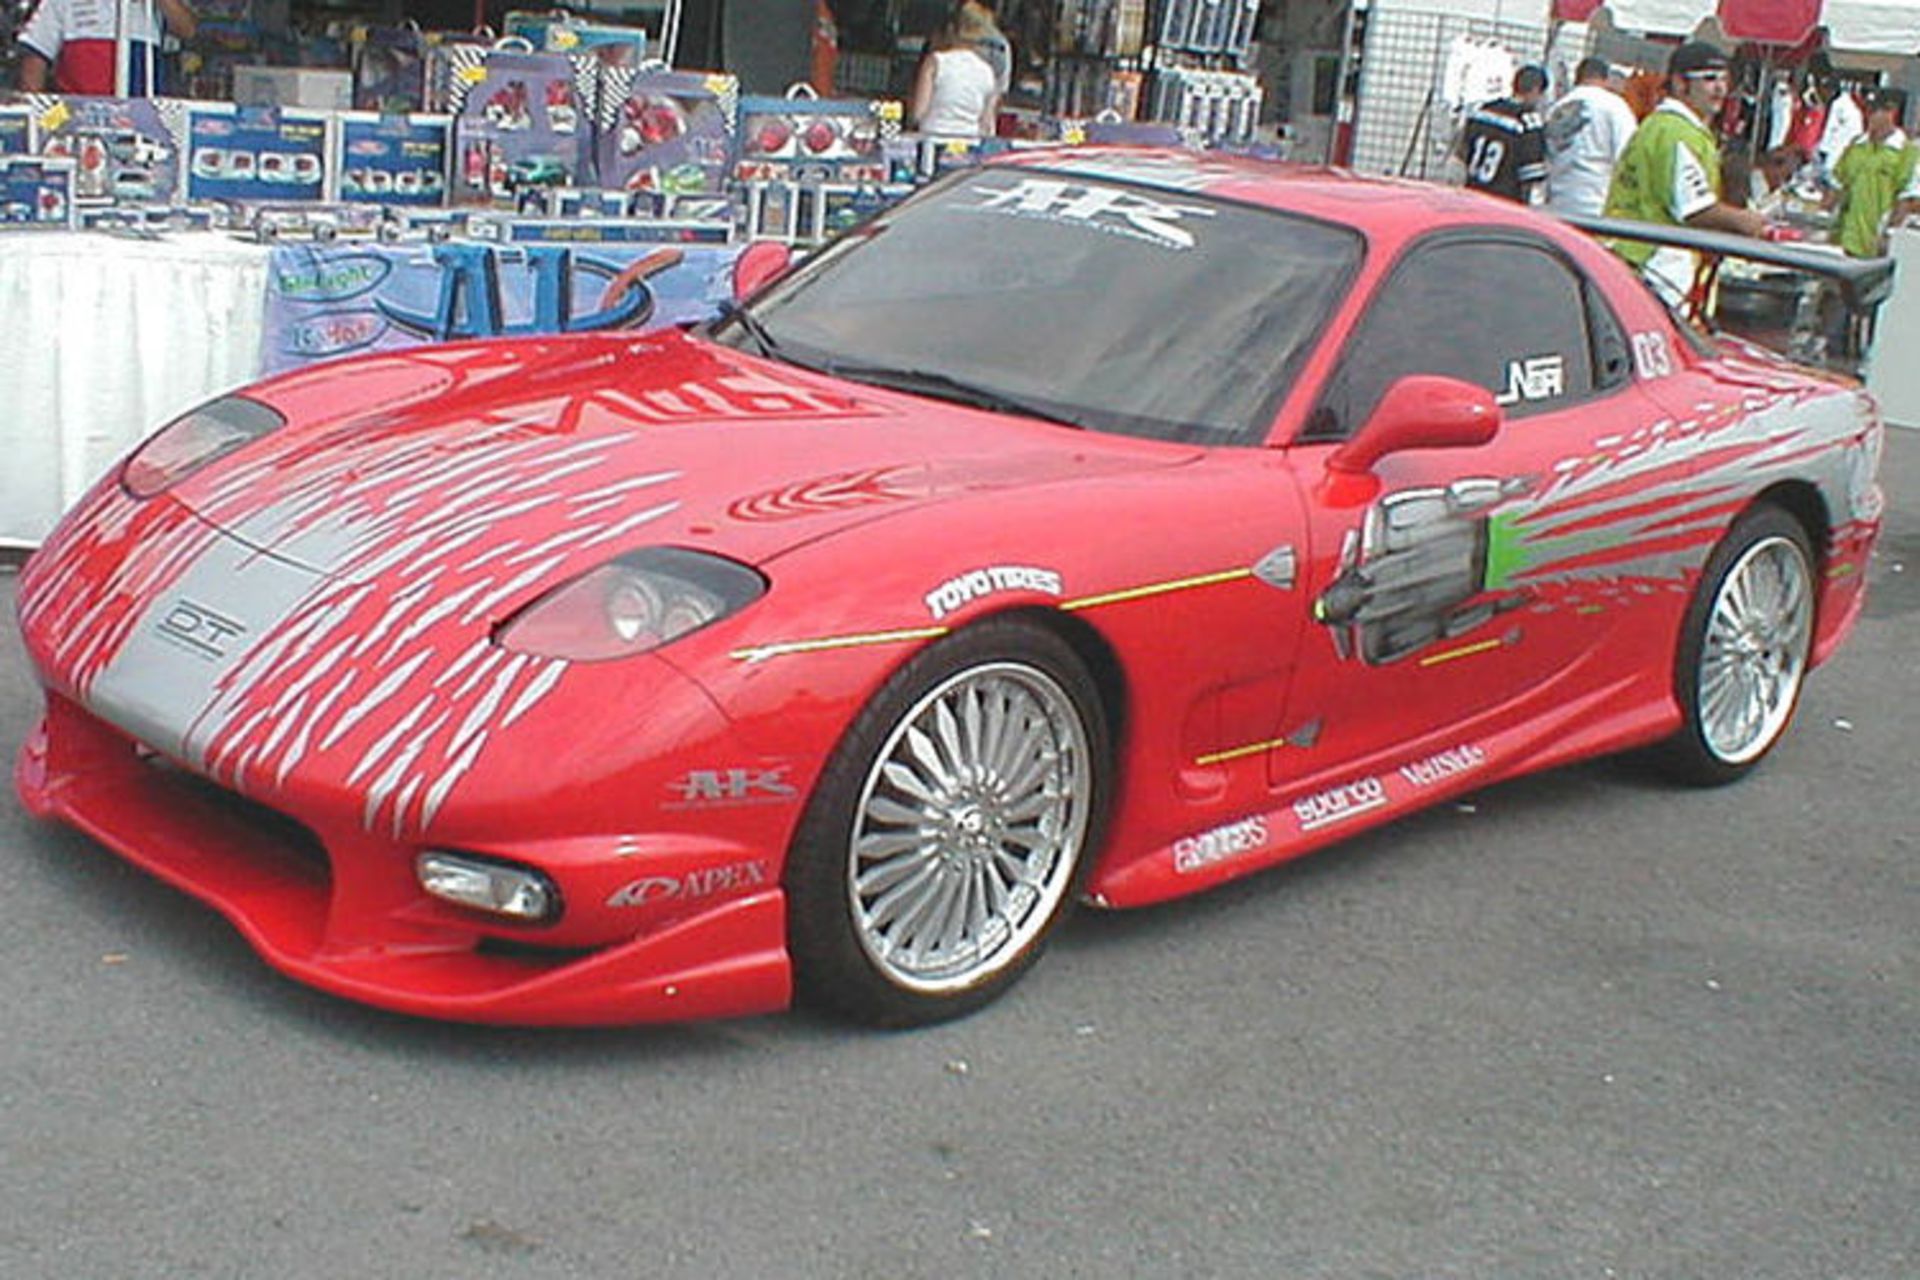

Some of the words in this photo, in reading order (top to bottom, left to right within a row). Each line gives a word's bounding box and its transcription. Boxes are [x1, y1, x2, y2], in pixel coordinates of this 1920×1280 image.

[1468, 135, 1504, 184] 13
[1632, 331, 1671, 379] 03
[925, 569, 992, 619] TOYO
[165, 607, 239, 643] DT
